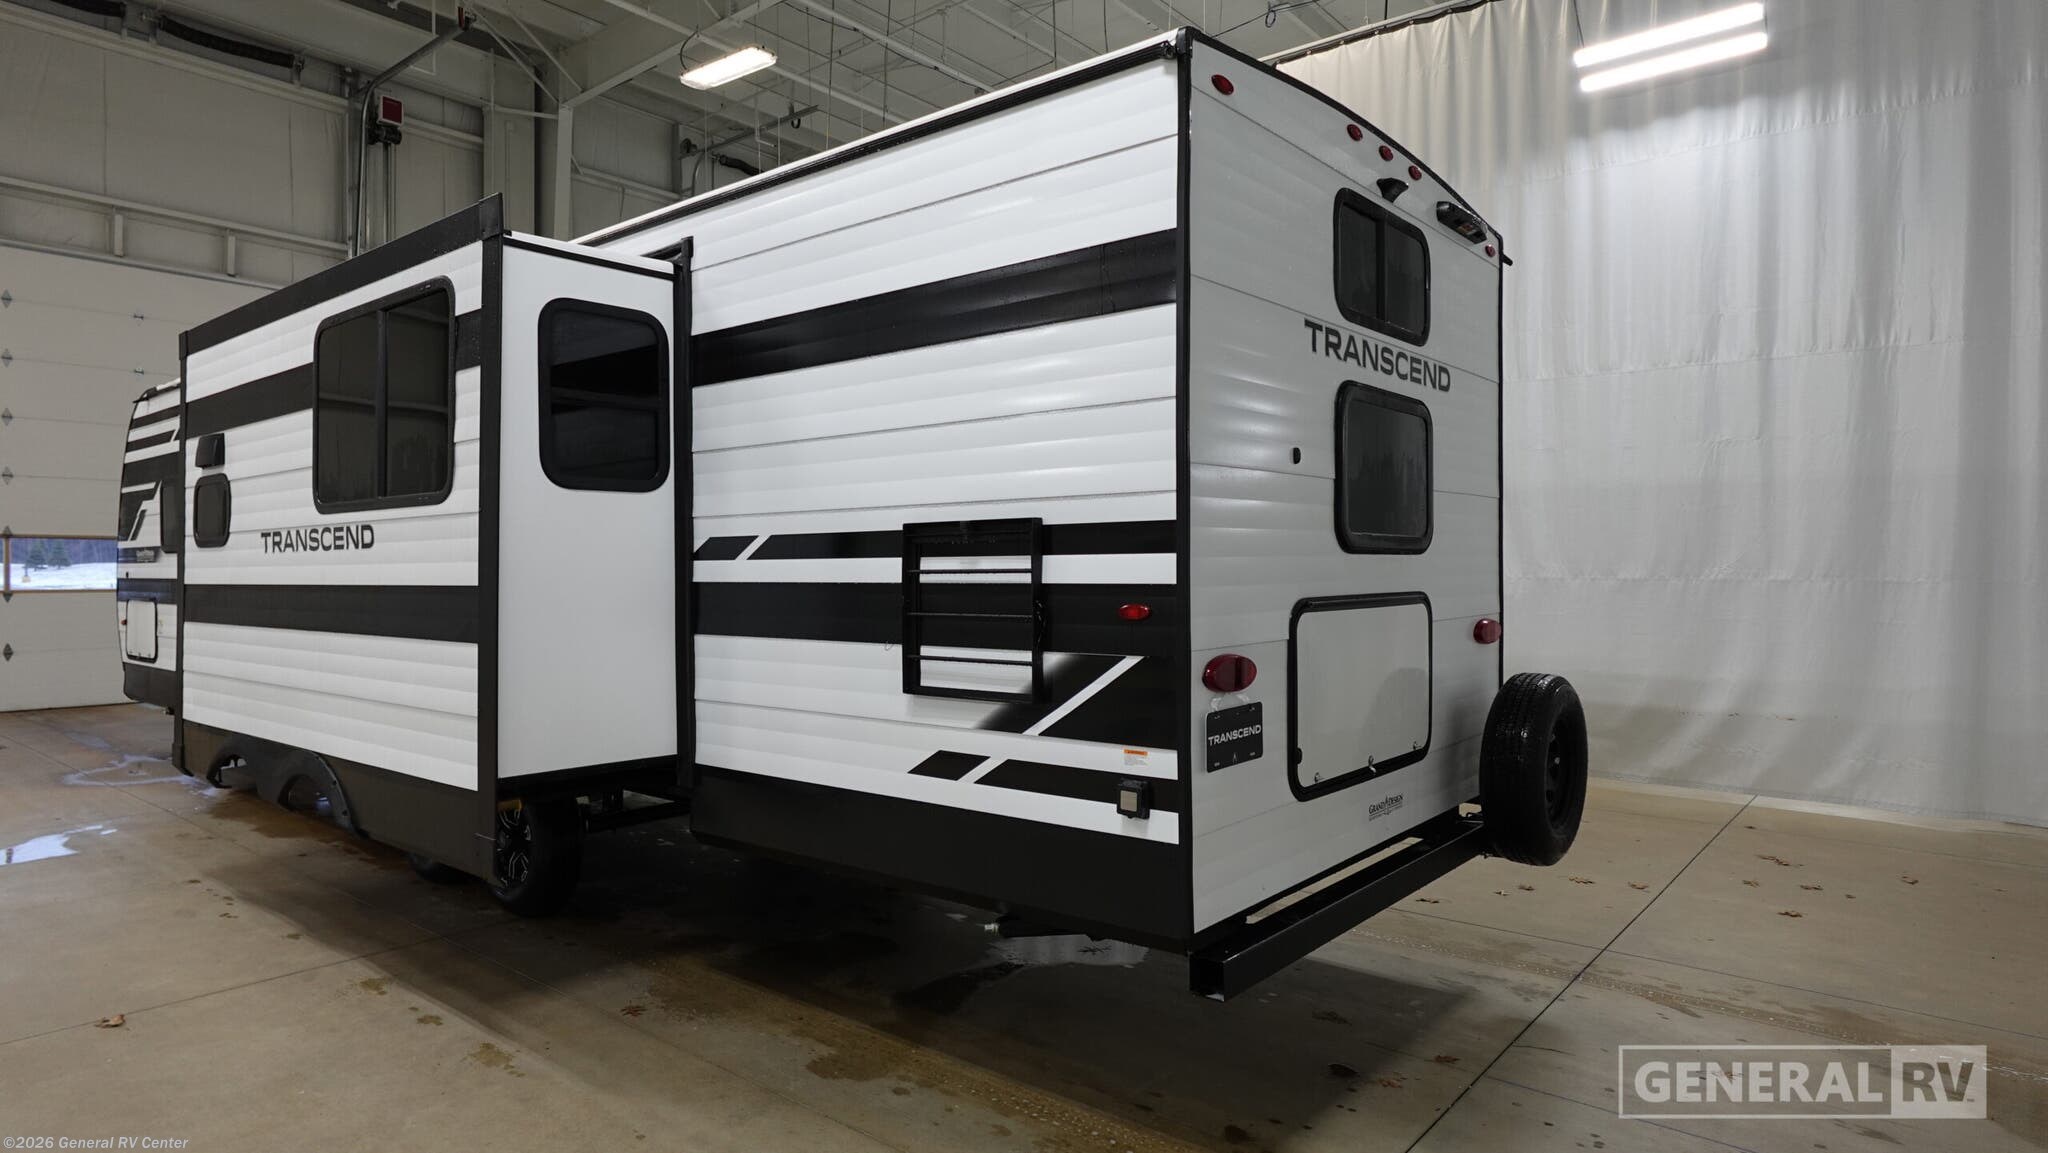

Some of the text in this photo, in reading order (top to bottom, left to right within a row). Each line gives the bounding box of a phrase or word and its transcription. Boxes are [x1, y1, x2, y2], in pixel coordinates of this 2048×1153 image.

[1304, 317, 1451, 393] TRANSCEND
[261, 524, 375, 553] TRANSCEND
[1208, 724, 1262, 746] TRANSCEND
